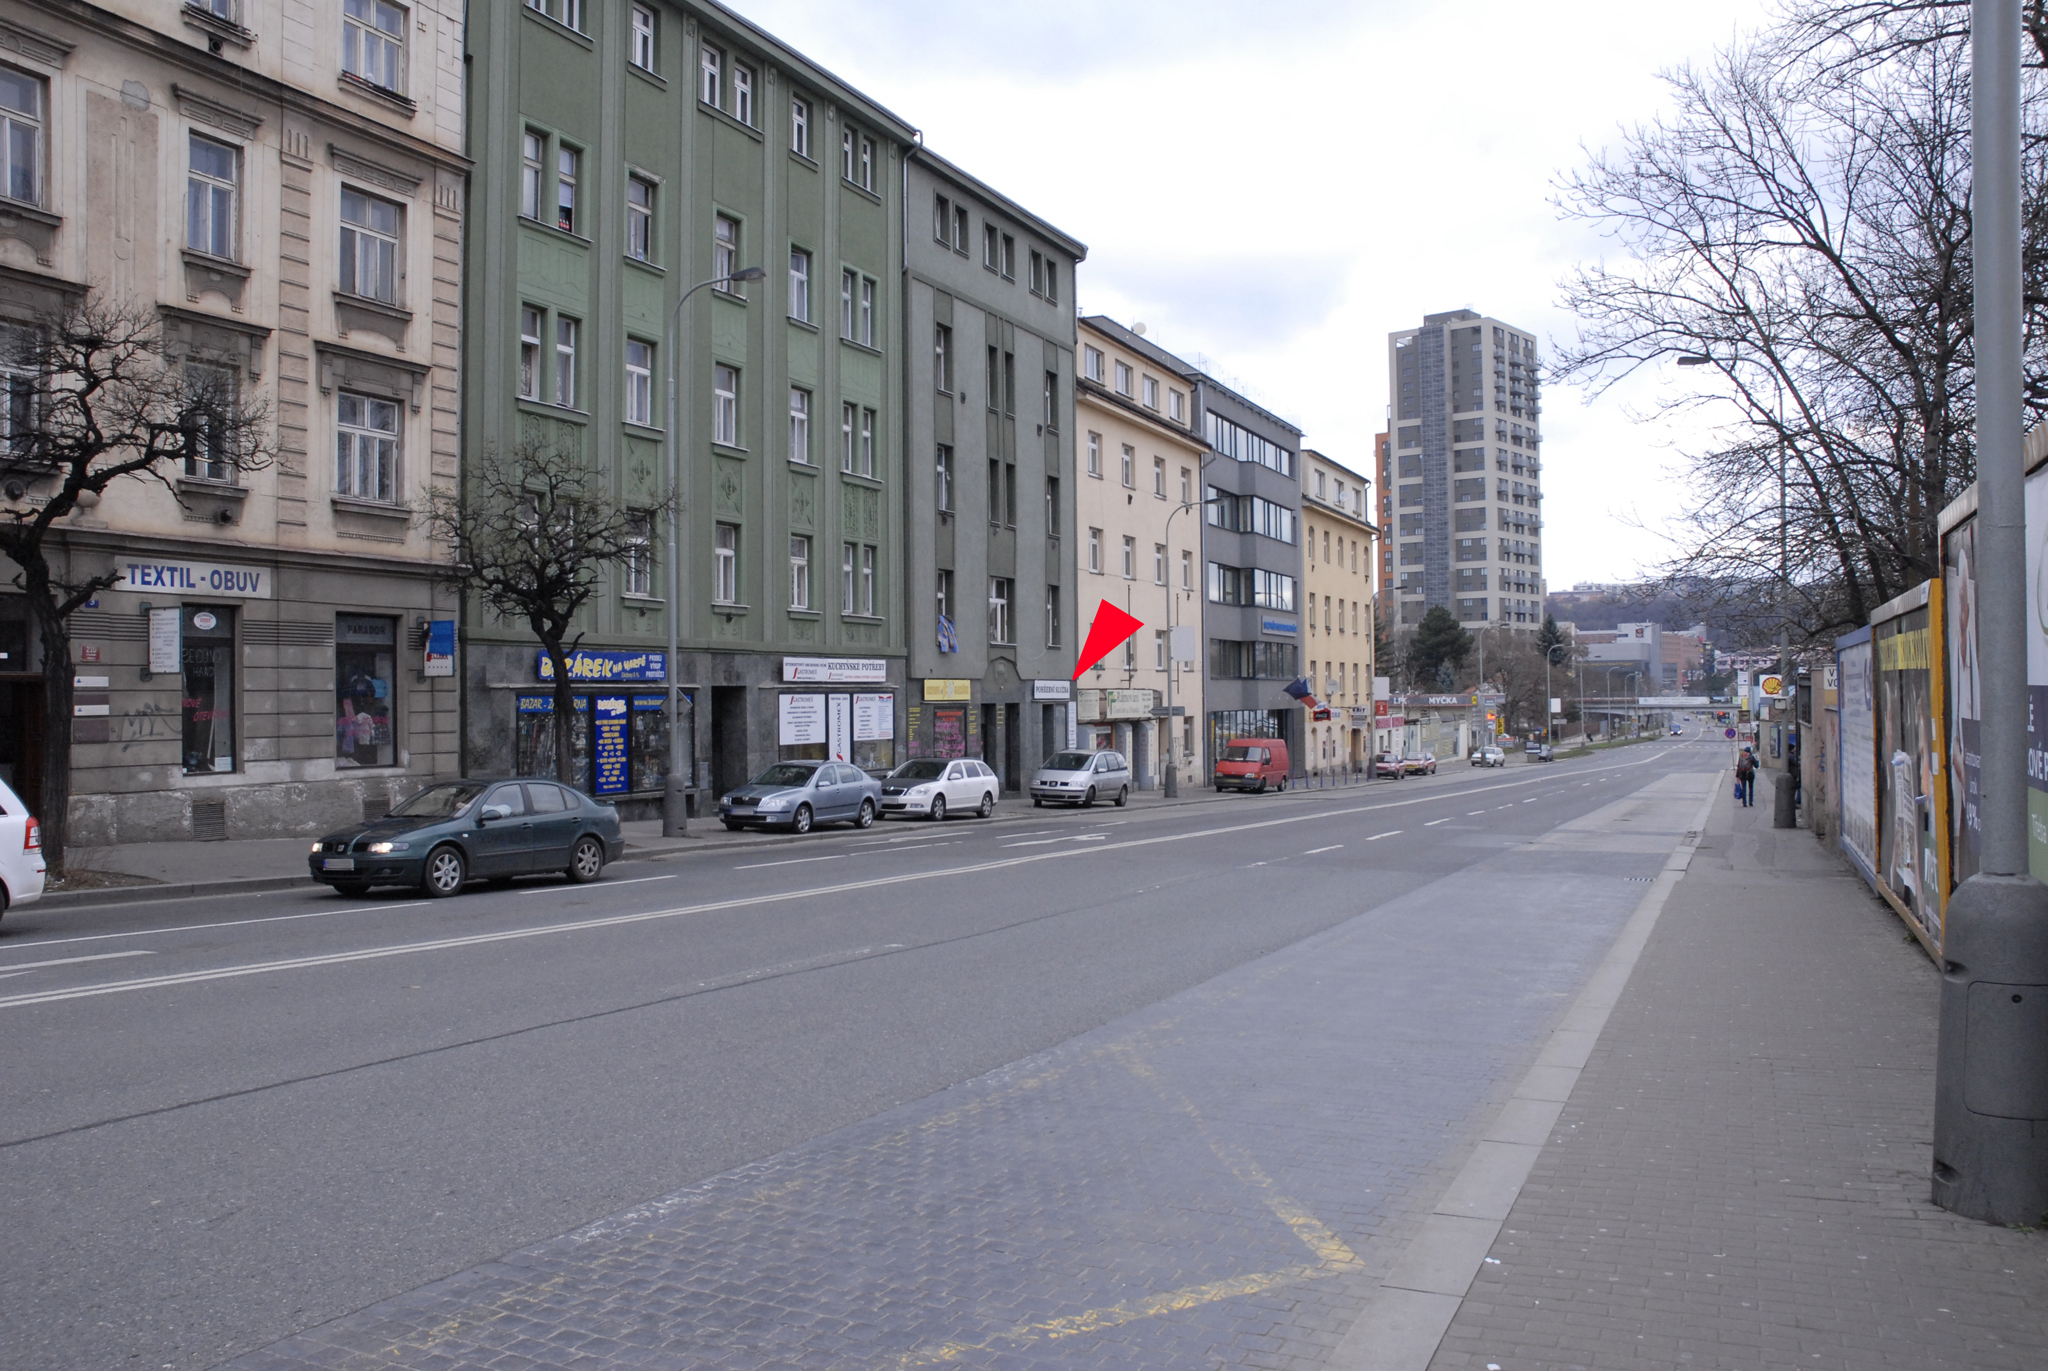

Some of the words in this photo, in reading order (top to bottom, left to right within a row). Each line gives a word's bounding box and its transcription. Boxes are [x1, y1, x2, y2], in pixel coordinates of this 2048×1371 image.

[127, 563, 196, 588] TEXTIL
[210, 569, 260, 592] OBUV
[347, 625, 386, 635] PARADOR
[541, 653, 613, 678] BZÁREK
[828, 660, 860, 671] KUCHYŇSKÉ
[861, 660, 885, 671] POTŘEBY
[520, 698, 543, 709] BAZAR
[1429, 695, 1458, 704] MYČKA
